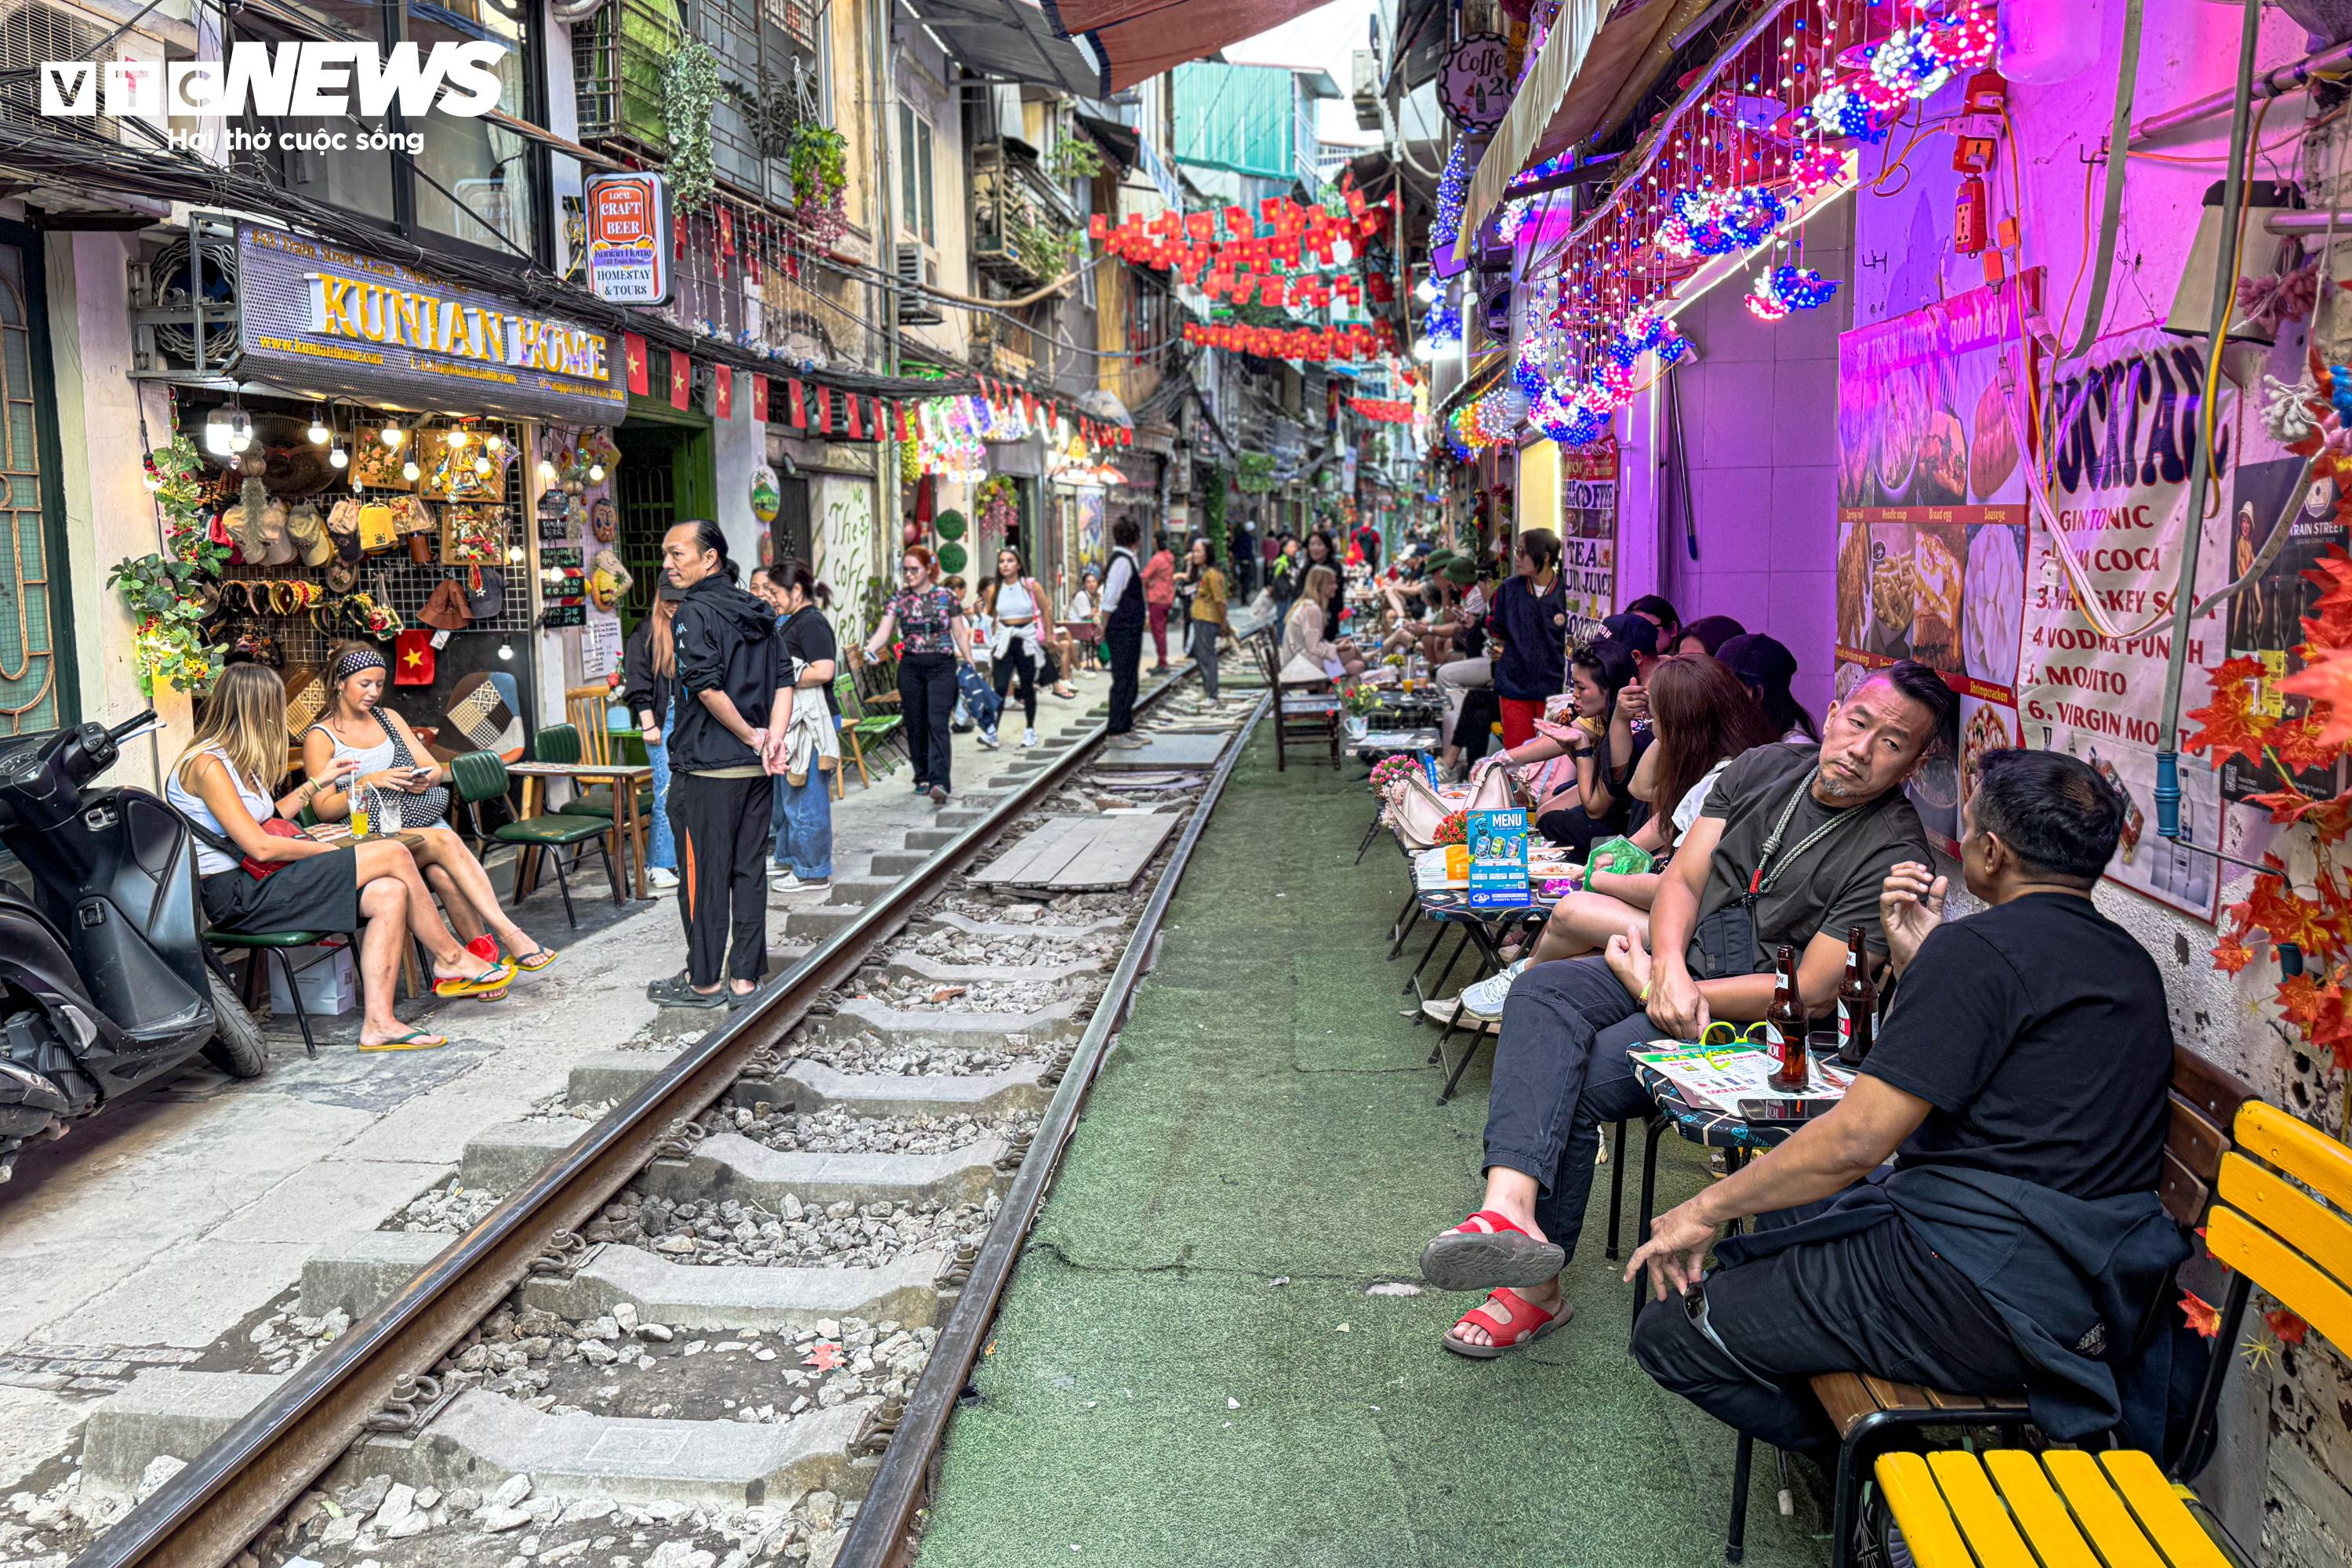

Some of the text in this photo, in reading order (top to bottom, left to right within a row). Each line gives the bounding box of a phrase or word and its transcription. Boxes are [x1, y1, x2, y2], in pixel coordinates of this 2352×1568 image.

[1457, 49, 1505, 76] Coffe
[609, 191, 631, 200] LOCAL
[601, 202, 641, 216] CRAFT
[607, 221, 640, 234] BEER
[595, 249, 652, 258] Kunian Home
[597, 269, 651, 281] HOMESTAY
[604, 285, 647, 295] & TOURS
[306, 274, 609, 381] KUNIAN HOME
[1856, 341, 1869, 371] 28
[1871, 332, 1900, 367] TRAIN
[1903, 325, 1939, 358] TRACK
[1950, 303, 1981, 350] good
[829, 502, 857, 545] The
[1882, 509, 1907, 521] Noodle soup
[1929, 508, 1952, 523] Bread egg
[2290, 524, 2311, 536] TRAIN
[1567, 541, 1599, 568] TEA
[2094, 547, 2161, 572] COCA
[1583, 572, 1612, 597] JUICE
[2057, 589, 2147, 613] WHSKEY
[2048, 627, 2120, 654] VODKA
[2126, 635, 2204, 666] PUNH
[2045, 665, 2127, 696] MOJITO
[2027, 699, 2053, 721] 6.
[2056, 702, 2123, 738] VIRGIN
[1492, 814, 1522, 827] MENU
